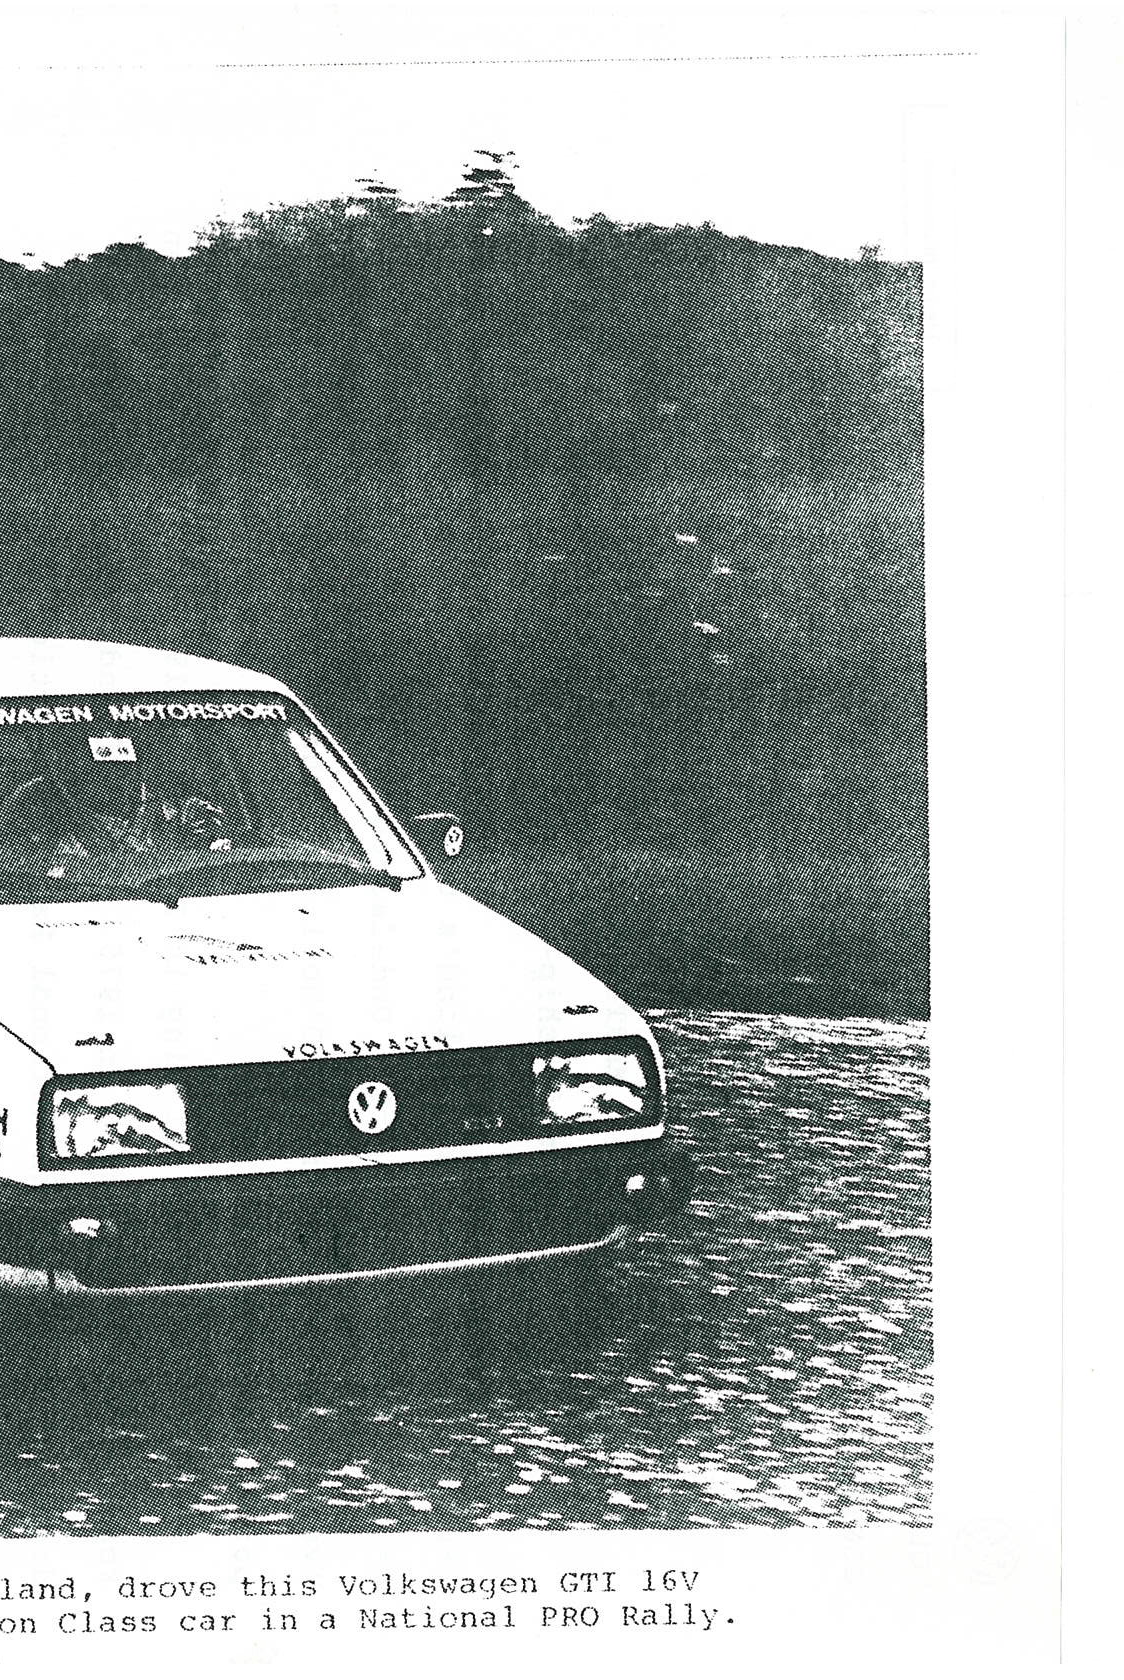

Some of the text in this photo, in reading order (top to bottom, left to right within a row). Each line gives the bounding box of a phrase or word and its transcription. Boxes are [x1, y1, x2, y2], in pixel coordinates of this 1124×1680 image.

[109, 703, 288, 722] MOTORSPORT
[119, 1577, 215, 1598] drove
[241, 1575, 316, 1596] this
[339, 1573, 537, 1599] Volkswagen
[560, 1572, 615, 1592] GTI
[643, 1570, 698, 1591] 16V
[59, 1611, 156, 1633] Class
[180, 1615, 236, 1631] car
[263, 1608, 296, 1630] in
[320, 1613, 335, 1629] a
[360, 1606, 515, 1628] National
[542, 1607, 599, 1626] PRO
[622, 1603, 737, 1630] Rally.
